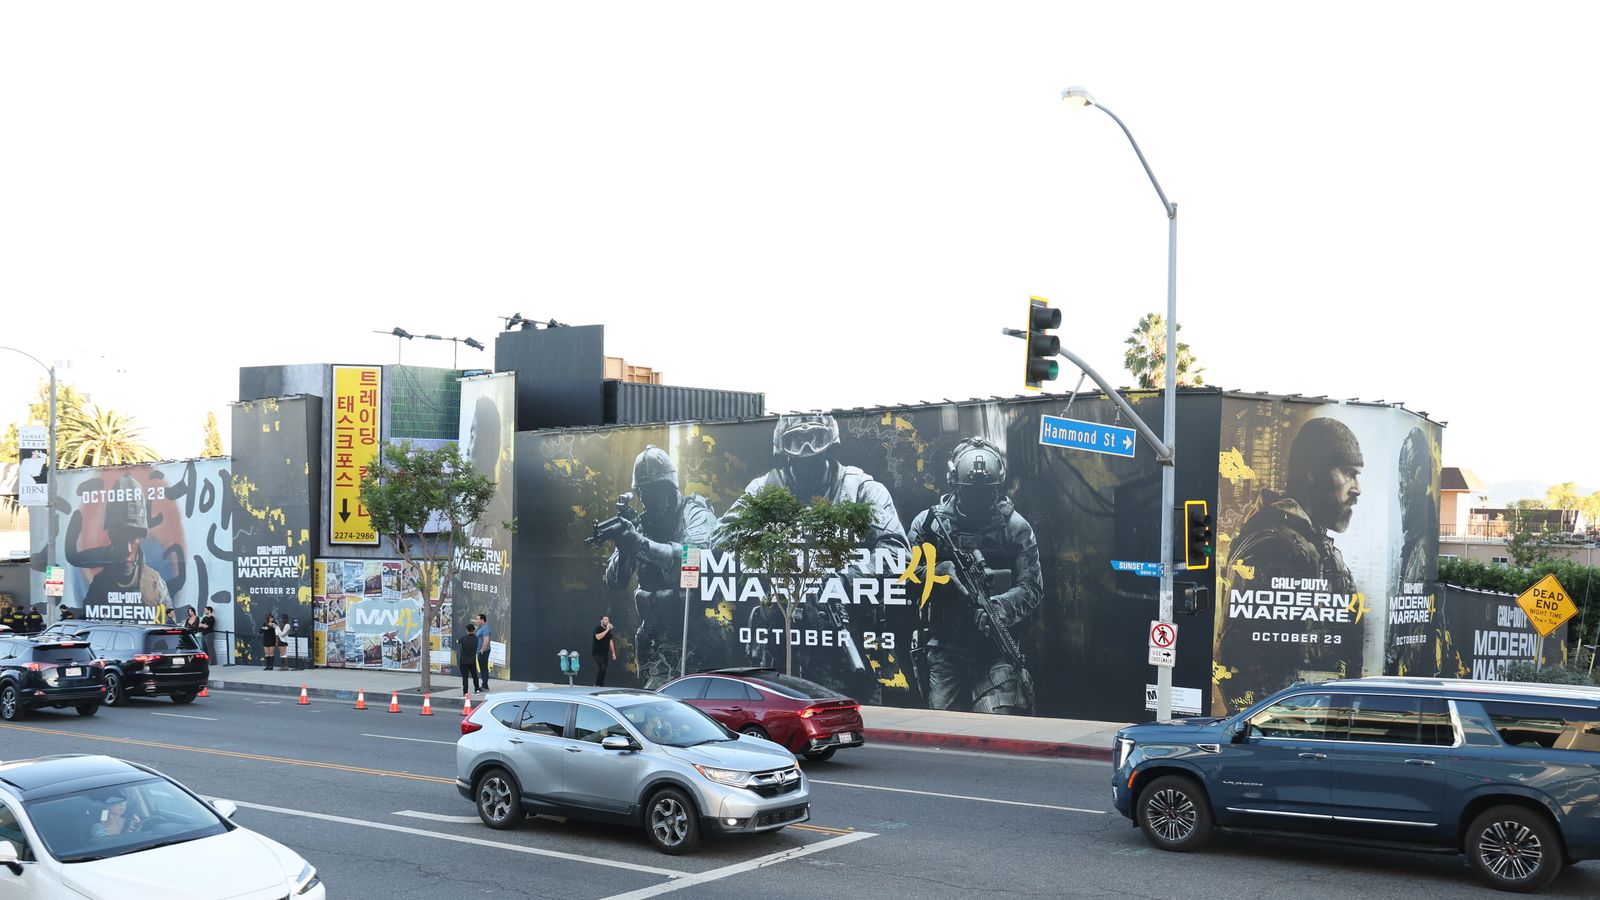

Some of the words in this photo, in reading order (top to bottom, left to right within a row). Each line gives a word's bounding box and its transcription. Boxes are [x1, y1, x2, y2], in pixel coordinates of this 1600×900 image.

[360, 371, 377, 445] 트레이딩
[336, 395, 354, 487] 태스크포스
[1044, 422, 1097, 444] Hammond
[1104, 433, 1116, 447] St
[82, 488, 142, 504] OCTOBER
[147, 487, 166, 500] 23
[334, 531, 375, 540] 2274-2986
[237, 555, 298, 567] MODERN
[1119, 561, 1145, 570] SUNSET
[238, 567, 299, 578] WARFARE
[249, 587, 283, 595] OCTOBER
[285, 587, 296, 595] 23
[463, 580, 489, 592] OCTOBER
[489, 585, 498, 594] 23
[1271, 577, 1296, 590] CALL
[1301, 578, 1328, 591] DUTY
[1230, 589, 1350, 608] MODERN
[1533, 588, 1564, 602] DEAD
[1389, 596, 1430, 610] MODERN
[1535, 599, 1559, 611] END
[85, 604, 156, 620] MODERN
[1389, 609, 1430, 625] WARFARE
[1529, 608, 1548, 617] NIGHT
[1549, 611, 1562, 620] TIME
[739, 627, 851, 647] OCTOBER
[863, 631, 895, 650] 23
[1252, 632, 1318, 643] OCTOBER
[1324, 635, 1342, 644] 23
[1395, 635, 1419, 646] OCTOBER
[1419, 634, 1427, 643] 23
[1473, 630, 1537, 657] MODERN
